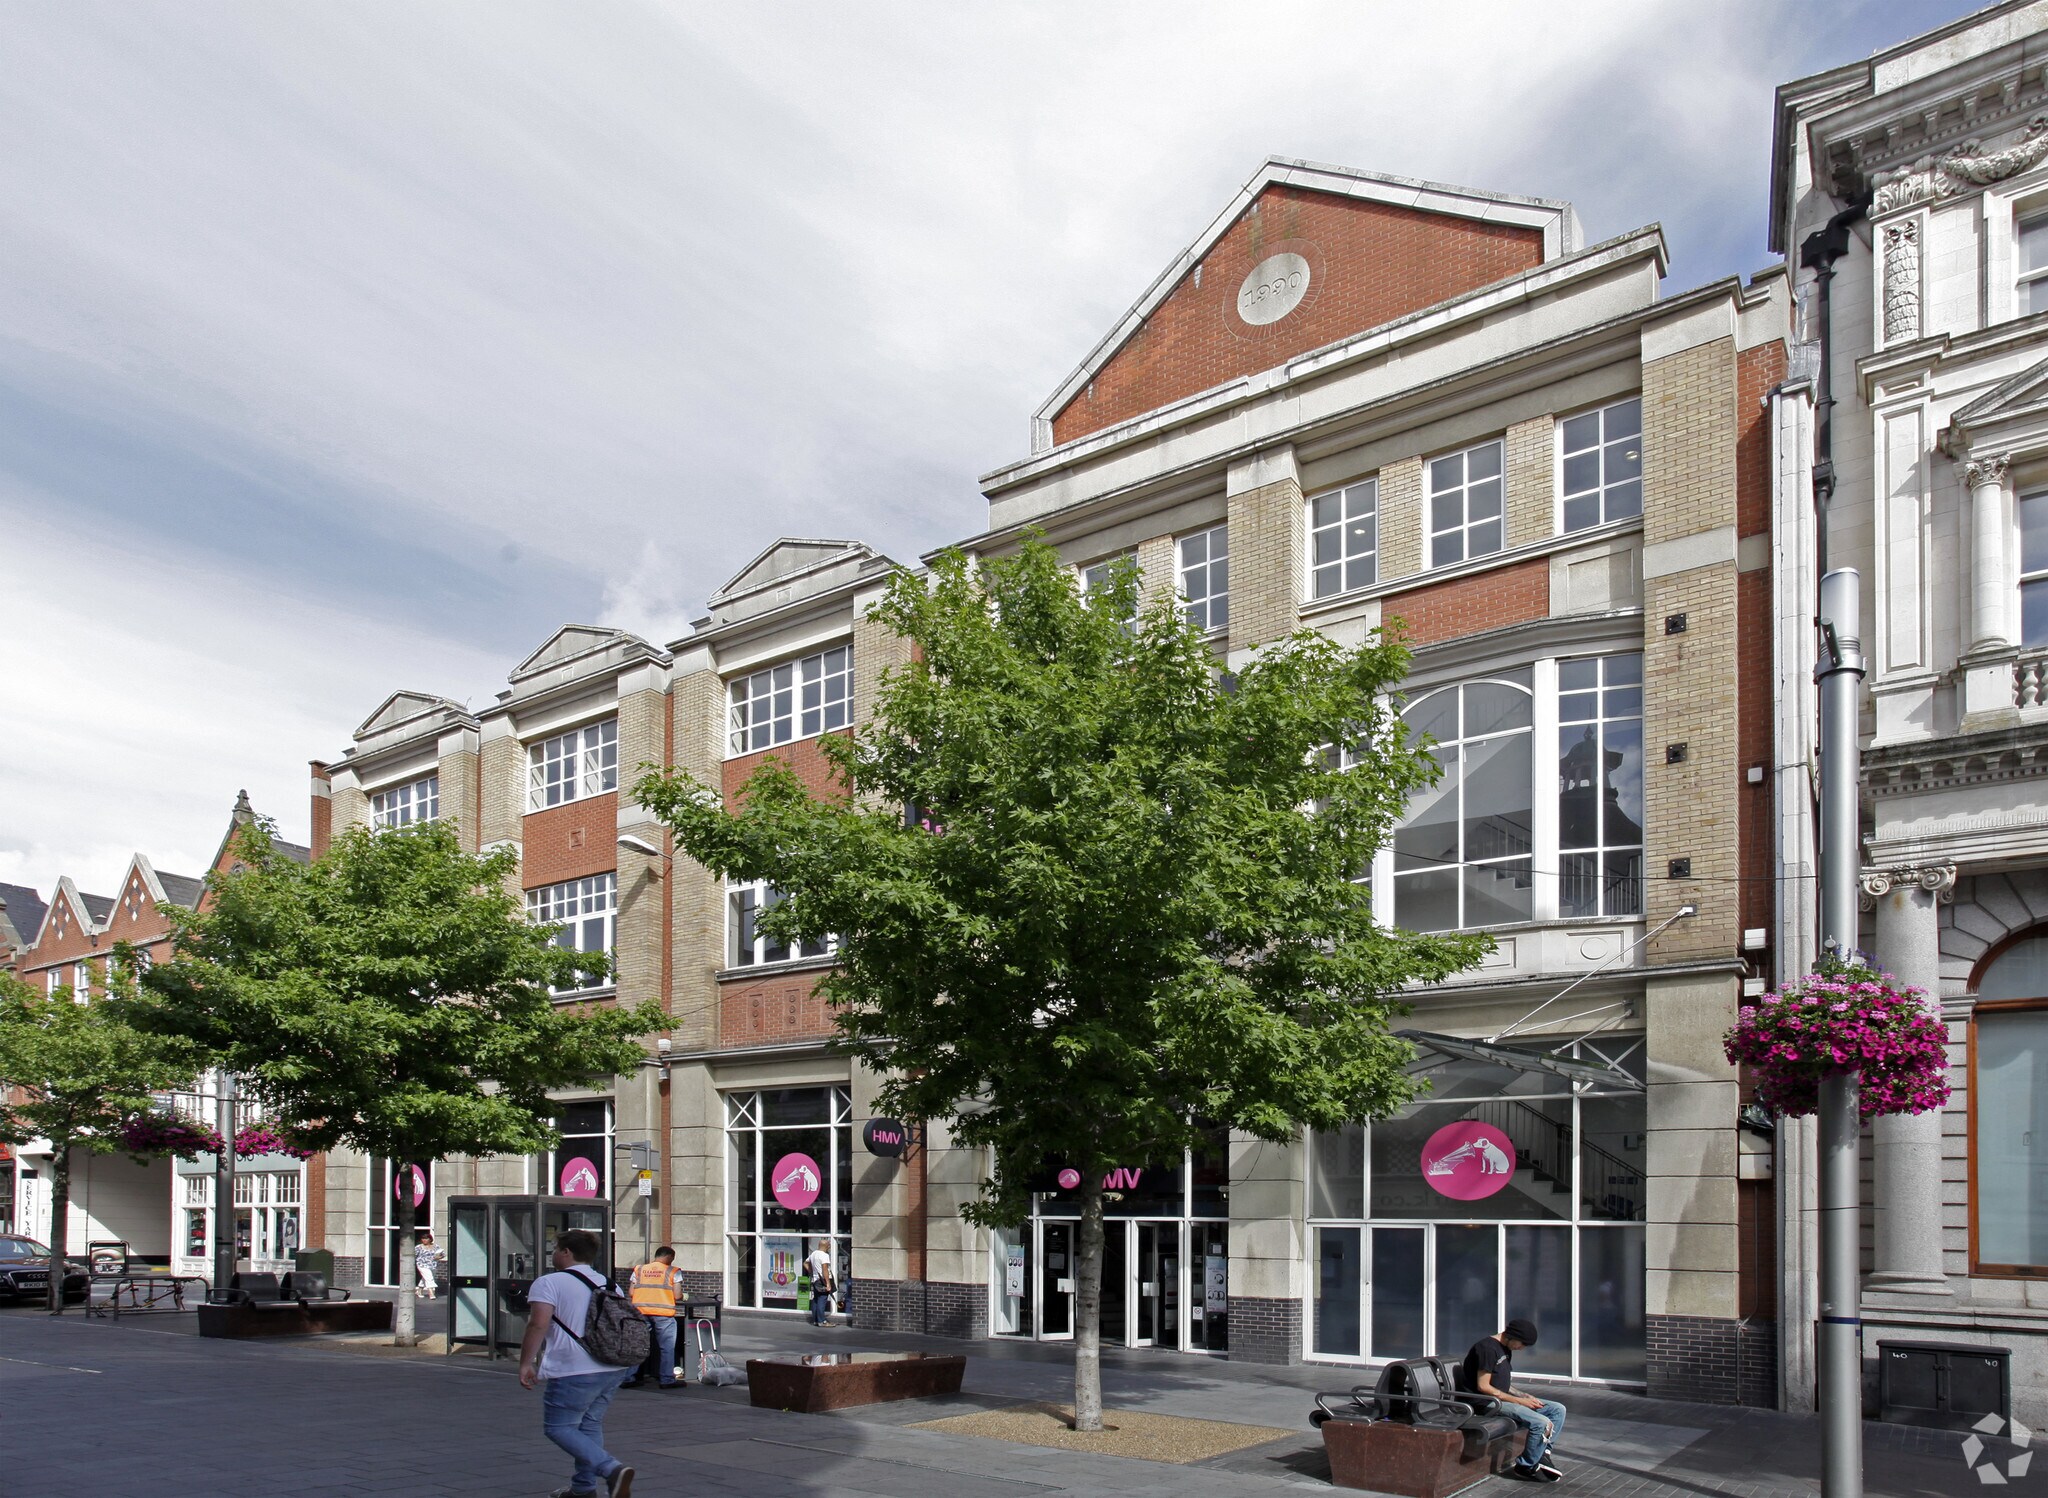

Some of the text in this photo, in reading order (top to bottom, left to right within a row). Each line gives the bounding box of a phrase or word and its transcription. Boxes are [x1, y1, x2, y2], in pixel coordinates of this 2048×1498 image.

[1243, 270, 1303, 308] 1990
[872, 1129, 901, 1145] HMV
[1101, 1167, 1142, 1189] MV
[25, 1179, 33, 1216] SERVICE
[1984, 1358, 1998, 1367] 40
